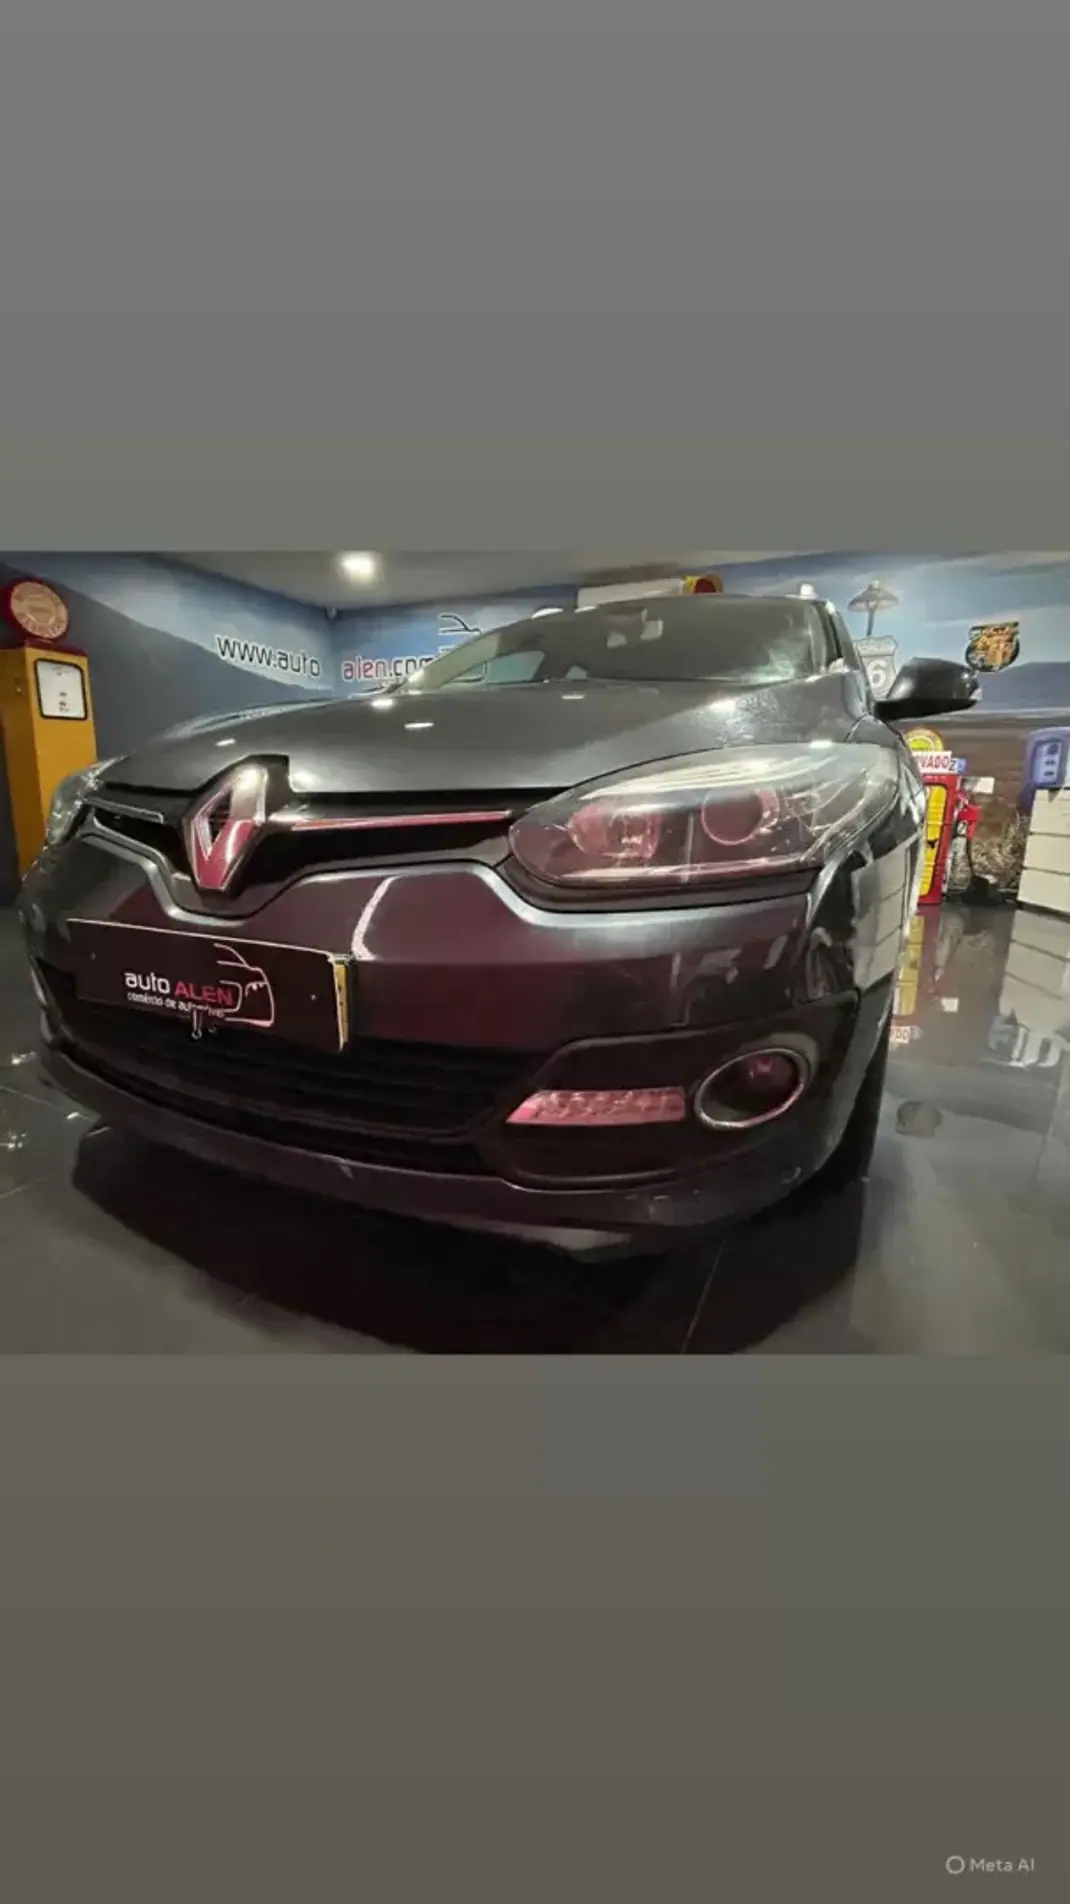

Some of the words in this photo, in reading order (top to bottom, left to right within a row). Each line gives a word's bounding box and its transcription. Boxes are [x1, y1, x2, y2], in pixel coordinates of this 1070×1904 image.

[216, 636, 321, 677] www.auto
[124, 972, 170, 994] auto
[174, 980, 233, 1006] ALEN
[164, 998, 177, 1010] de
